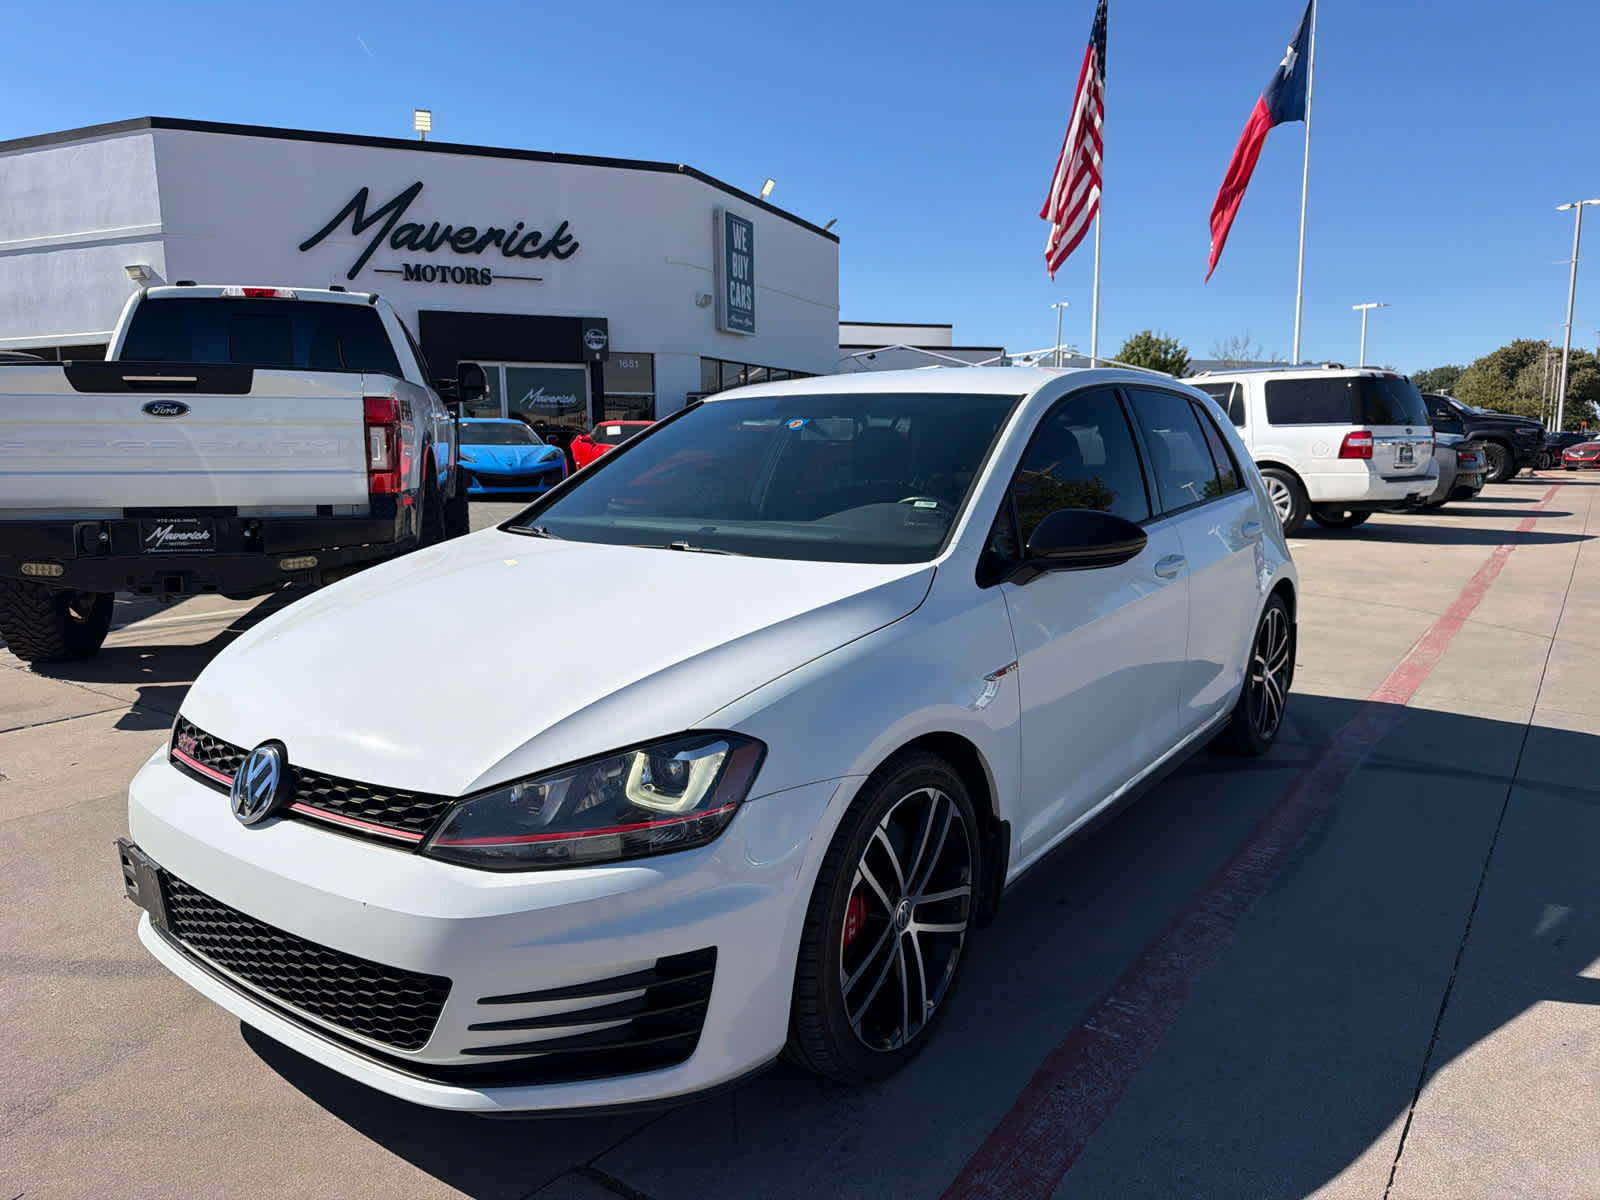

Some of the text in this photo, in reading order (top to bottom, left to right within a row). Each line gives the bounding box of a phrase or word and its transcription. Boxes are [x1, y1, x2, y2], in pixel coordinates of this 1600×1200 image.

[298, 181, 579, 280] Maverick
[732, 222, 748, 252] WE
[402, 263, 492, 286] MOTORS
[732, 252, 749, 281] BUY
[729, 280, 752, 310] CARS
[149, 402, 182, 417] Ford
[144, 524, 211, 548] Maverick
